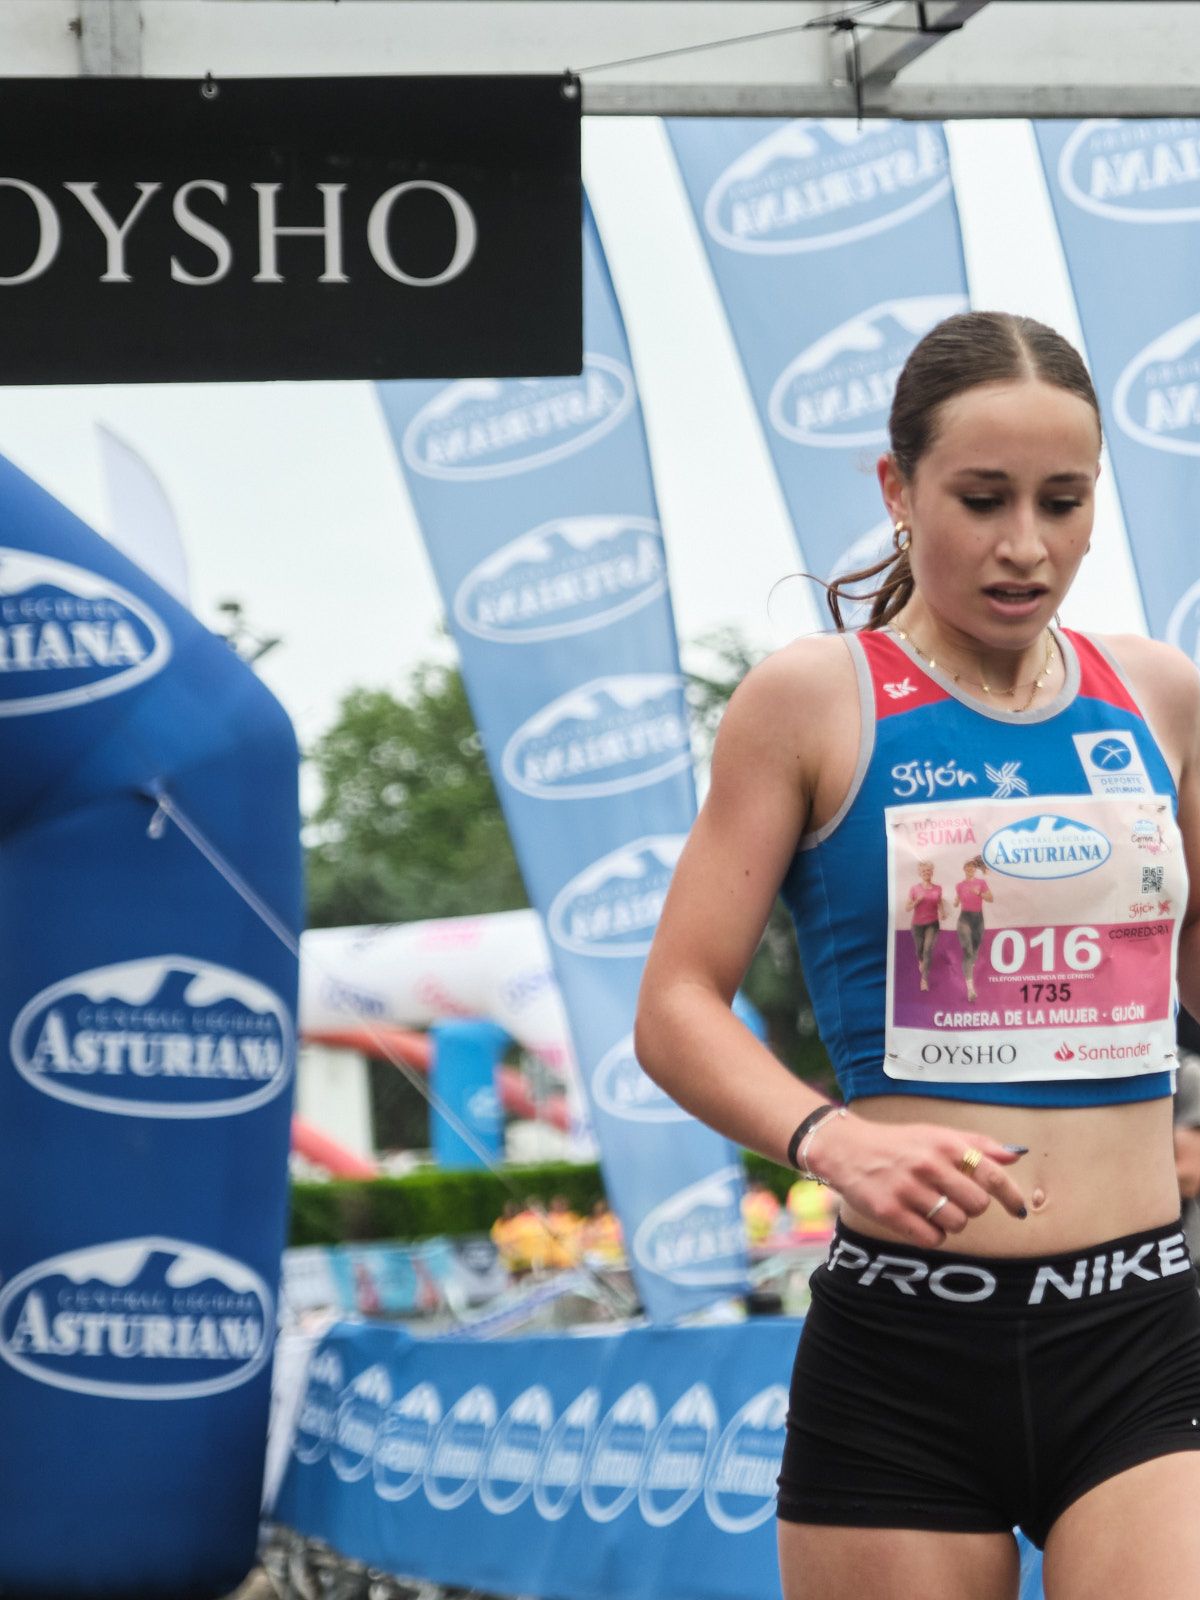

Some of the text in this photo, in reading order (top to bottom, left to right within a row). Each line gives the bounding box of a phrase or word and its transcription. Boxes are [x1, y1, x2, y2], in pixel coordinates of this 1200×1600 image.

[0, 177, 477, 287] OYSHO
[916, 828, 977, 847] SUMA
[993, 841, 1103, 865] ASTURIANA
[990, 926, 1101, 974] 016
[1020, 983, 1072, 1004] 1735
[933, 1002, 1145, 1028] CARRERA DE LA MUJER GIJÓN
[921, 1044, 1017, 1065] OYSHO
[1079, 1042, 1151, 1060] Santander
[827, 1232, 996, 1302] PRO
[1027, 1231, 1192, 1305] NIKE
